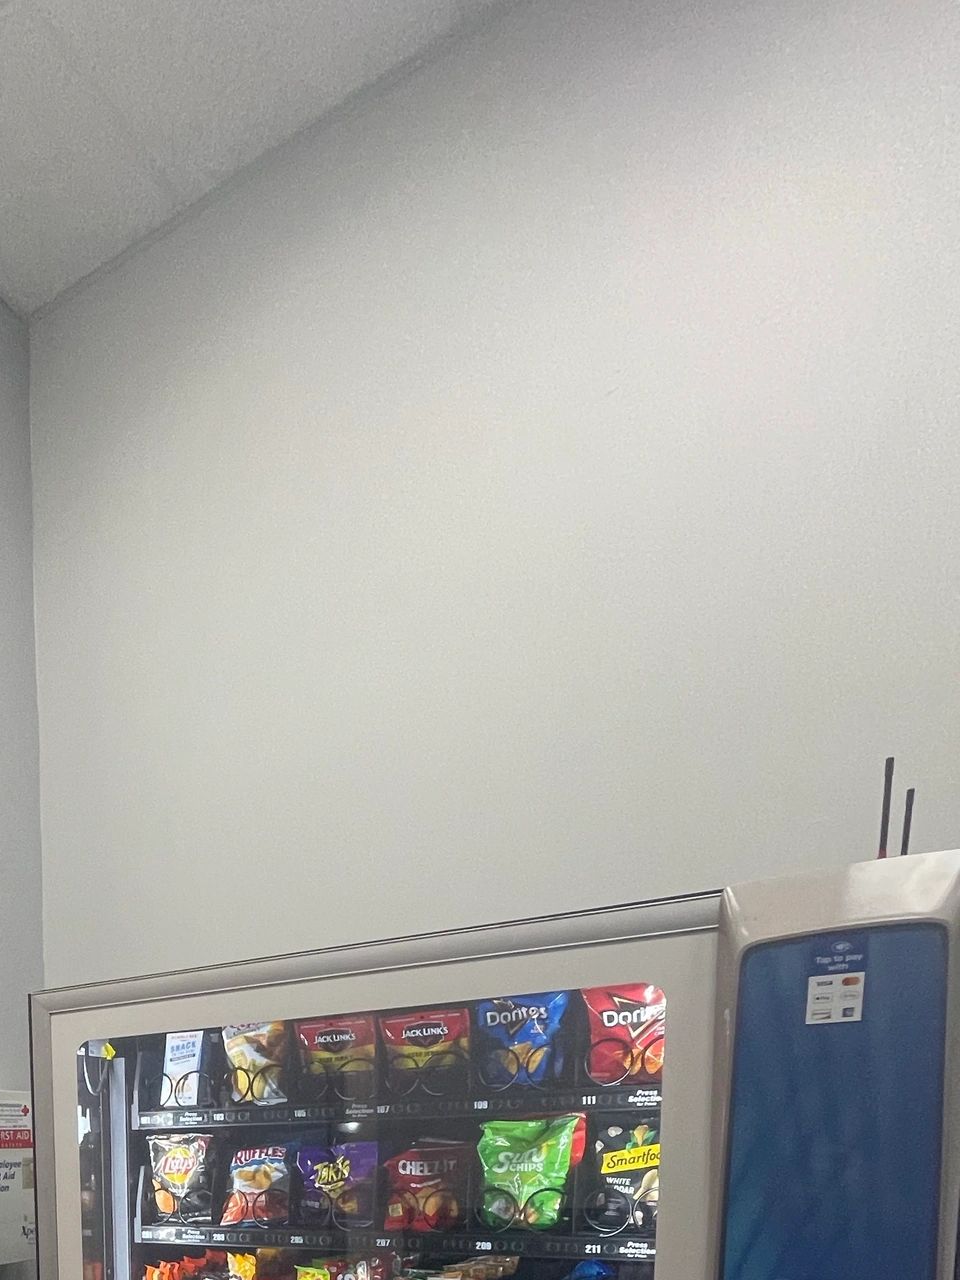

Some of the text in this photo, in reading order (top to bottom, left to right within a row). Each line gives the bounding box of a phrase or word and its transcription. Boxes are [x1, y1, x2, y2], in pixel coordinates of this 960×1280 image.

[486, 1006, 548, 1026] Doritos
[401, 1026, 449, 1039] JACK LINK'S
[314, 1035, 333, 1044] JACK
[582, 1096, 596, 1105] 111
[16, 1131, 30, 1140] AID
[232, 1147, 286, 1165] RUFFLES
[509, 1162, 544, 1172] CHIPS
[3, 1171, 15, 1180] Aid
[606, 1177, 631, 1185] WHITE
[376, 1238, 390, 1247] 207
[585, 1245, 601, 1254] 211
